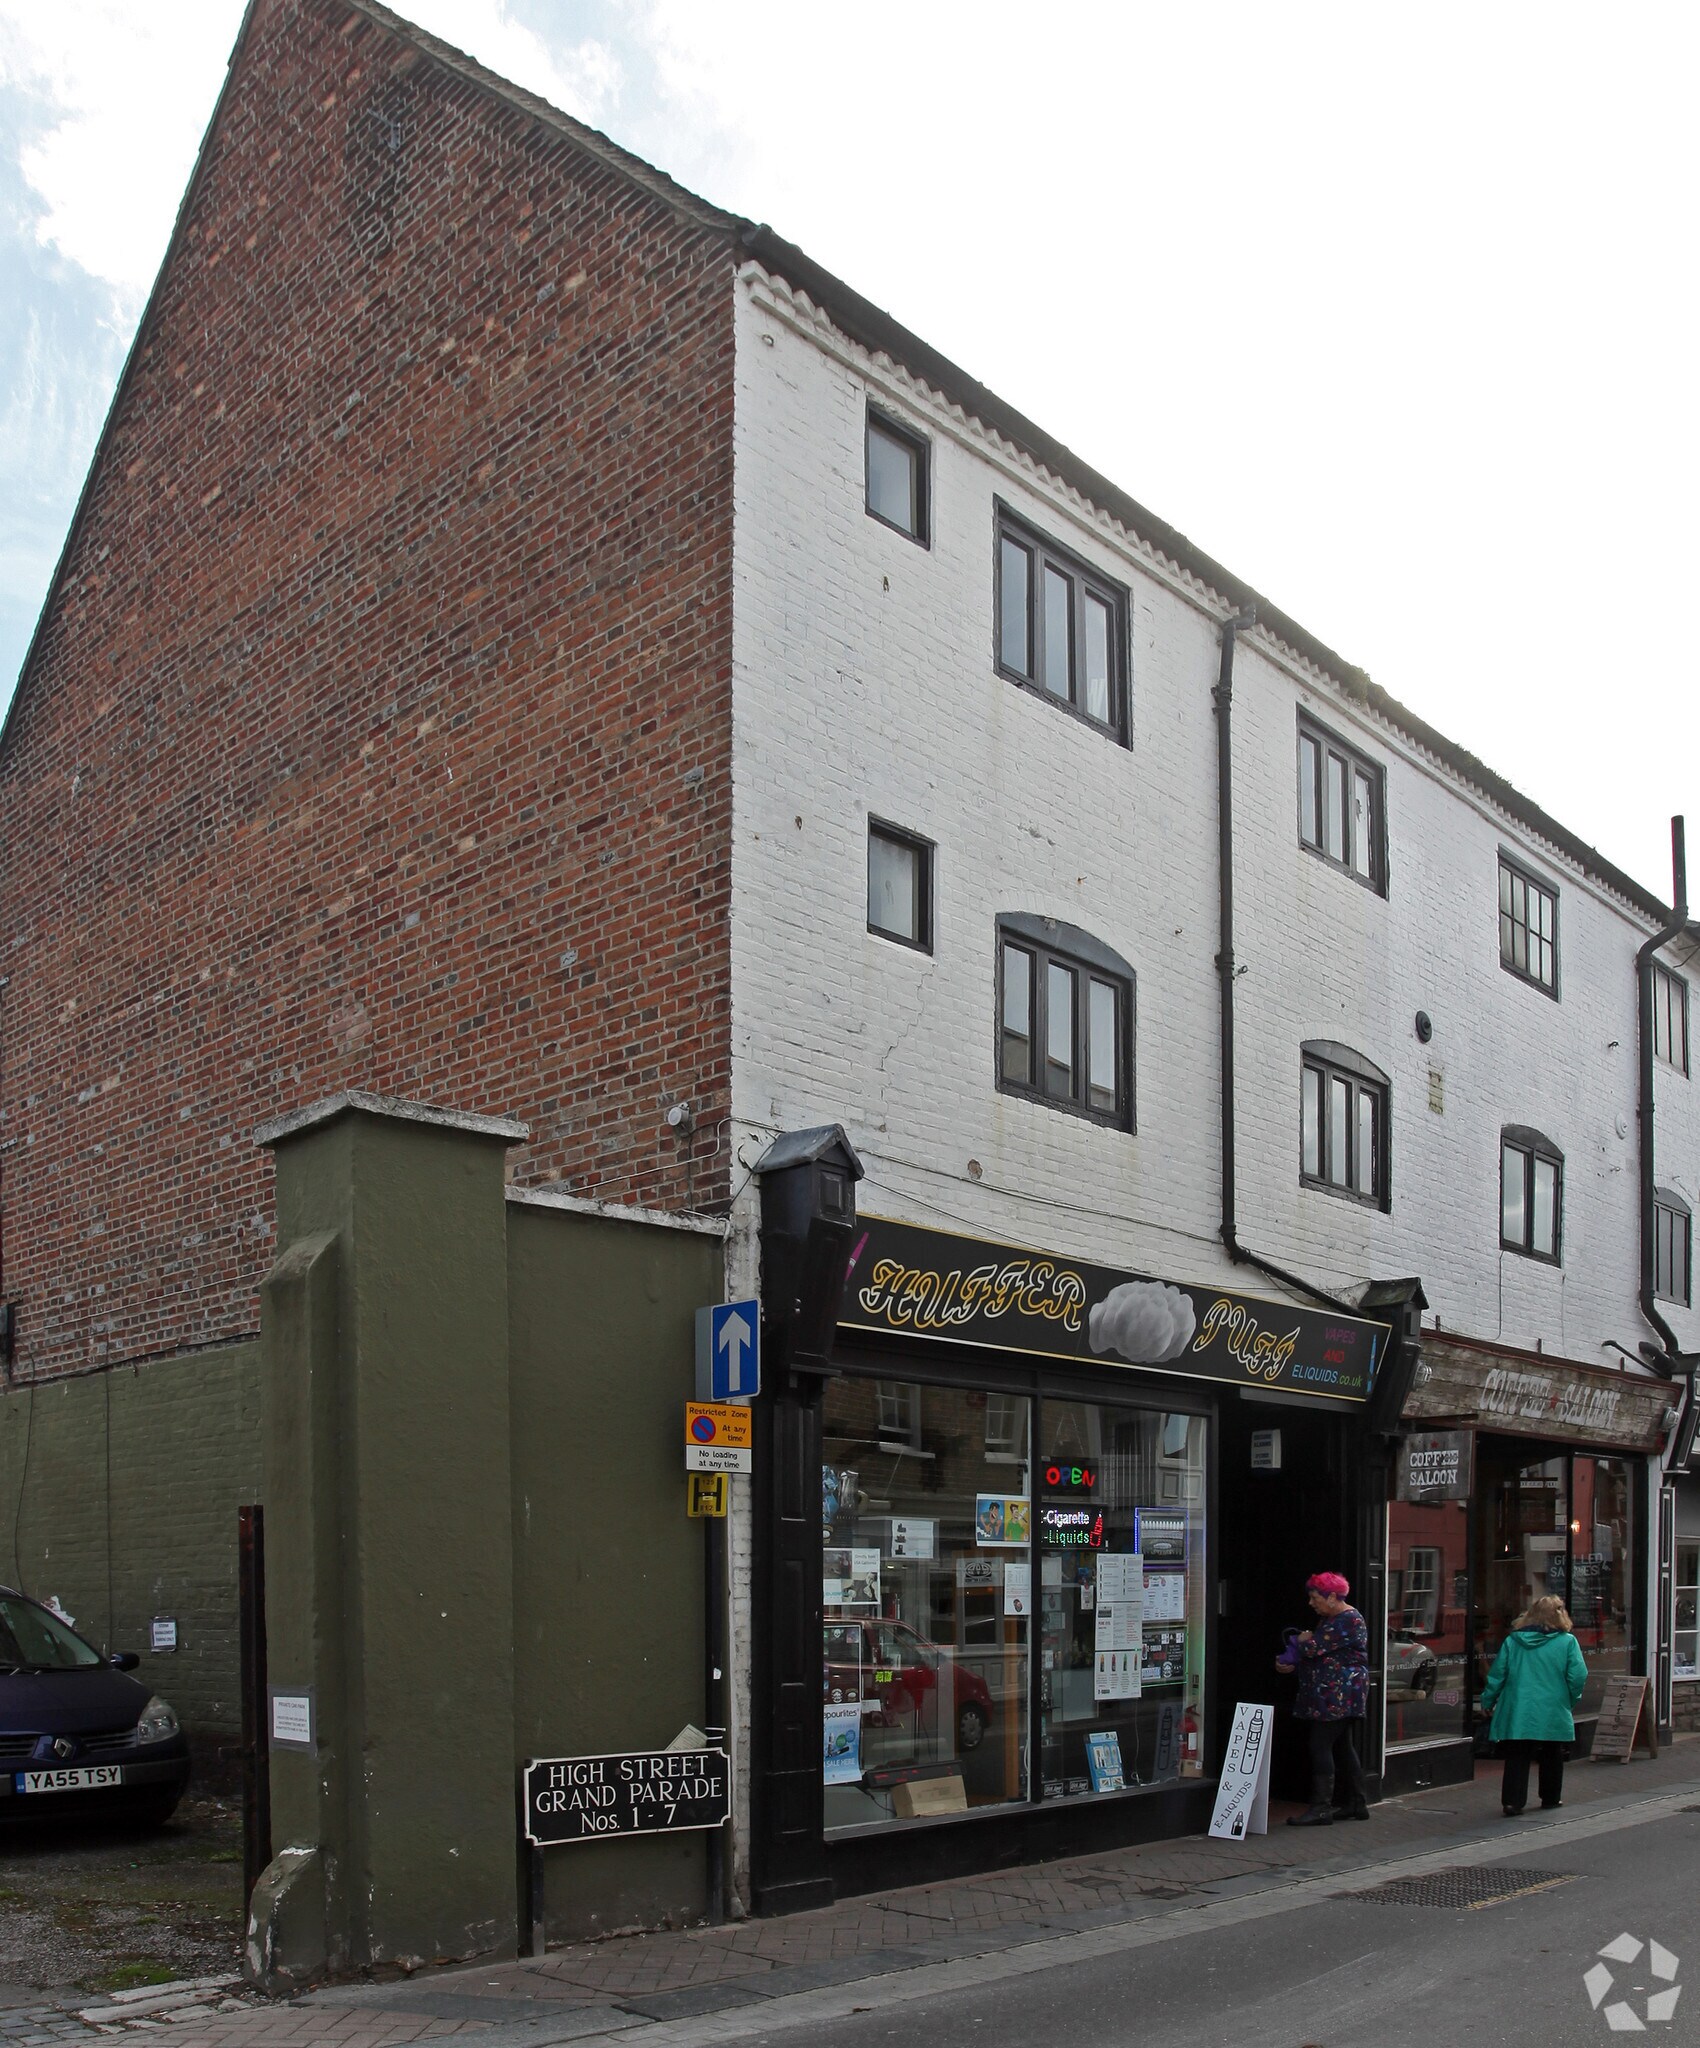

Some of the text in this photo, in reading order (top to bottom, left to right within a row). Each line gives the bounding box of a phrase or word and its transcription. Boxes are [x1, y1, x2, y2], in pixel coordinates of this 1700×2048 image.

[859, 1258, 1301, 1381] HUFFER PUFF
[1325, 1327, 1357, 1345] VAPES
[1323, 1349, 1345, 1364] AND
[1292, 1364, 1363, 1388] ELIQUIDS.co.uk
[1479, 1368, 1621, 1430] COFFEE SALOON
[689, 1407, 748, 1419] Restricted Zone
[727, 1434, 743, 1442] time
[699, 1450, 738, 1460] No loading
[699, 1459, 740, 1469] at any time
[1410, 1450, 1459, 1467] COFFEE
[1046, 1466, 1097, 1488] OPEN
[1410, 1469, 1458, 1486] SALOON
[1041, 1529, 1090, 1547] -Liquids
[1227, 1706, 1249, 1773] VAPES
[549, 1755, 709, 1788] HIGH STREET
[826, 1760, 841, 1768] SALE
[30, 1767, 118, 1789] YA55 TSY
[1222, 1780, 1233, 1792] &
[536, 1777, 722, 1813] GRAND PARADE
[1214, 1780, 1253, 1829] E-LIQUIDS
[581, 1811, 621, 1834] Nos.
[632, 1807, 640, 1828] 1
[664, 1803, 677, 1825] 7
